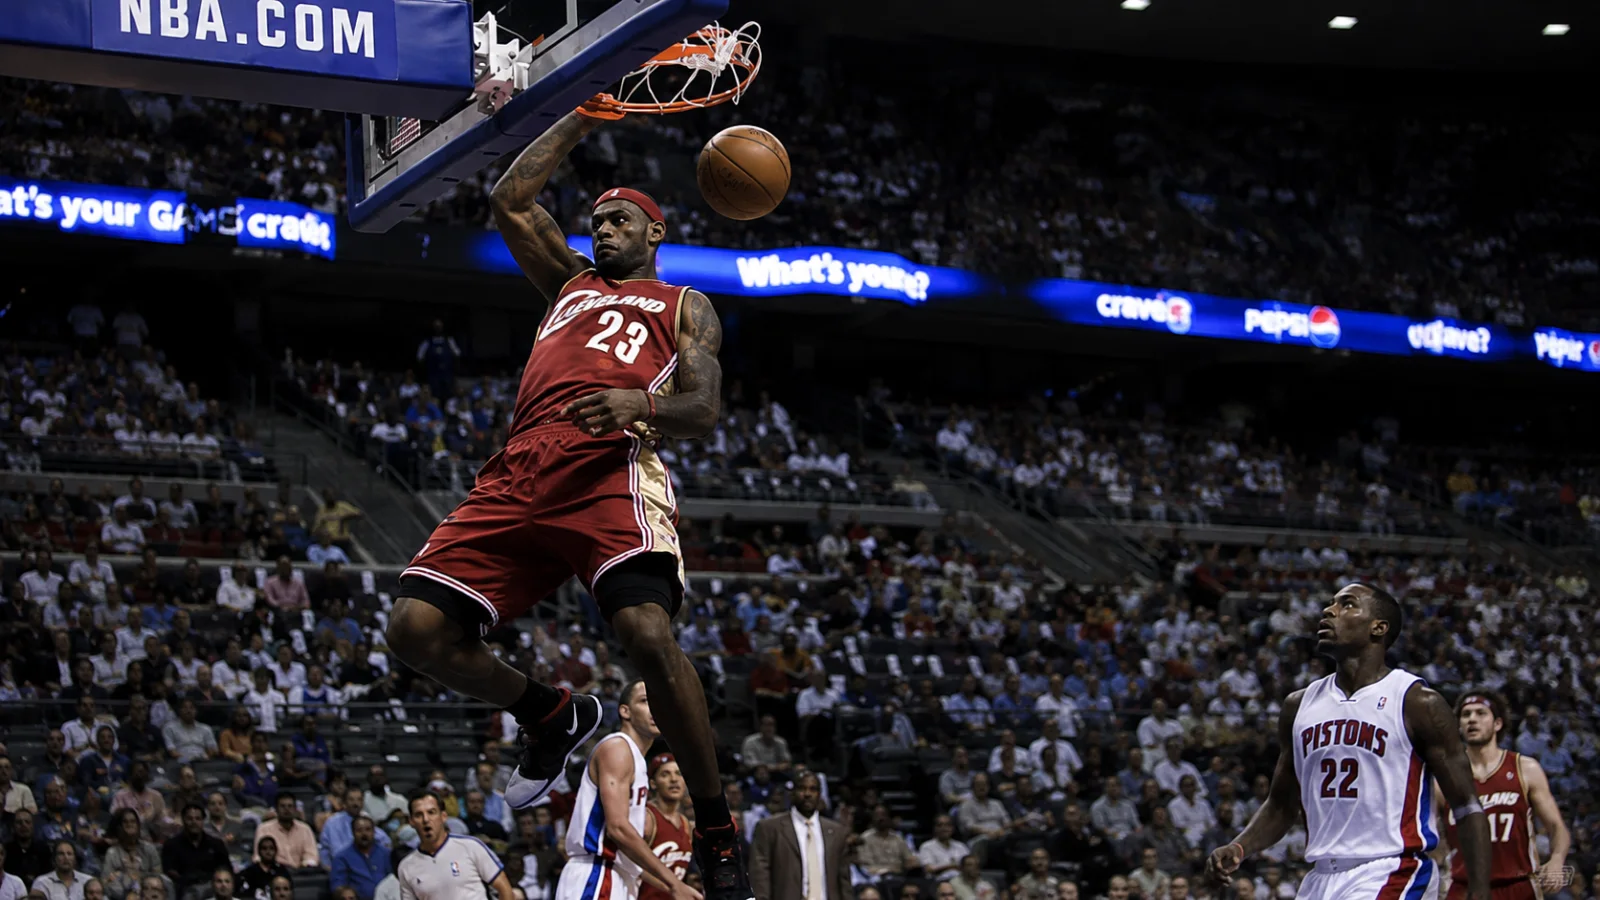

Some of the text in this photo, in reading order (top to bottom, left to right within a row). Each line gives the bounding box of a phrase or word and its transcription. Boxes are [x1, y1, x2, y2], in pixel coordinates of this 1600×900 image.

[119, 0, 376, 59] NBA.COM
[60, 195, 141, 229] your
[736, 252, 845, 288] What's
[538, 289, 667, 341] CLEVELAND
[585, 310, 649, 364] 23
[1301, 718, 1389, 759] PISTONS
[1320, 757, 1359, 799] 22
[1487, 812, 1515, 842] 17
